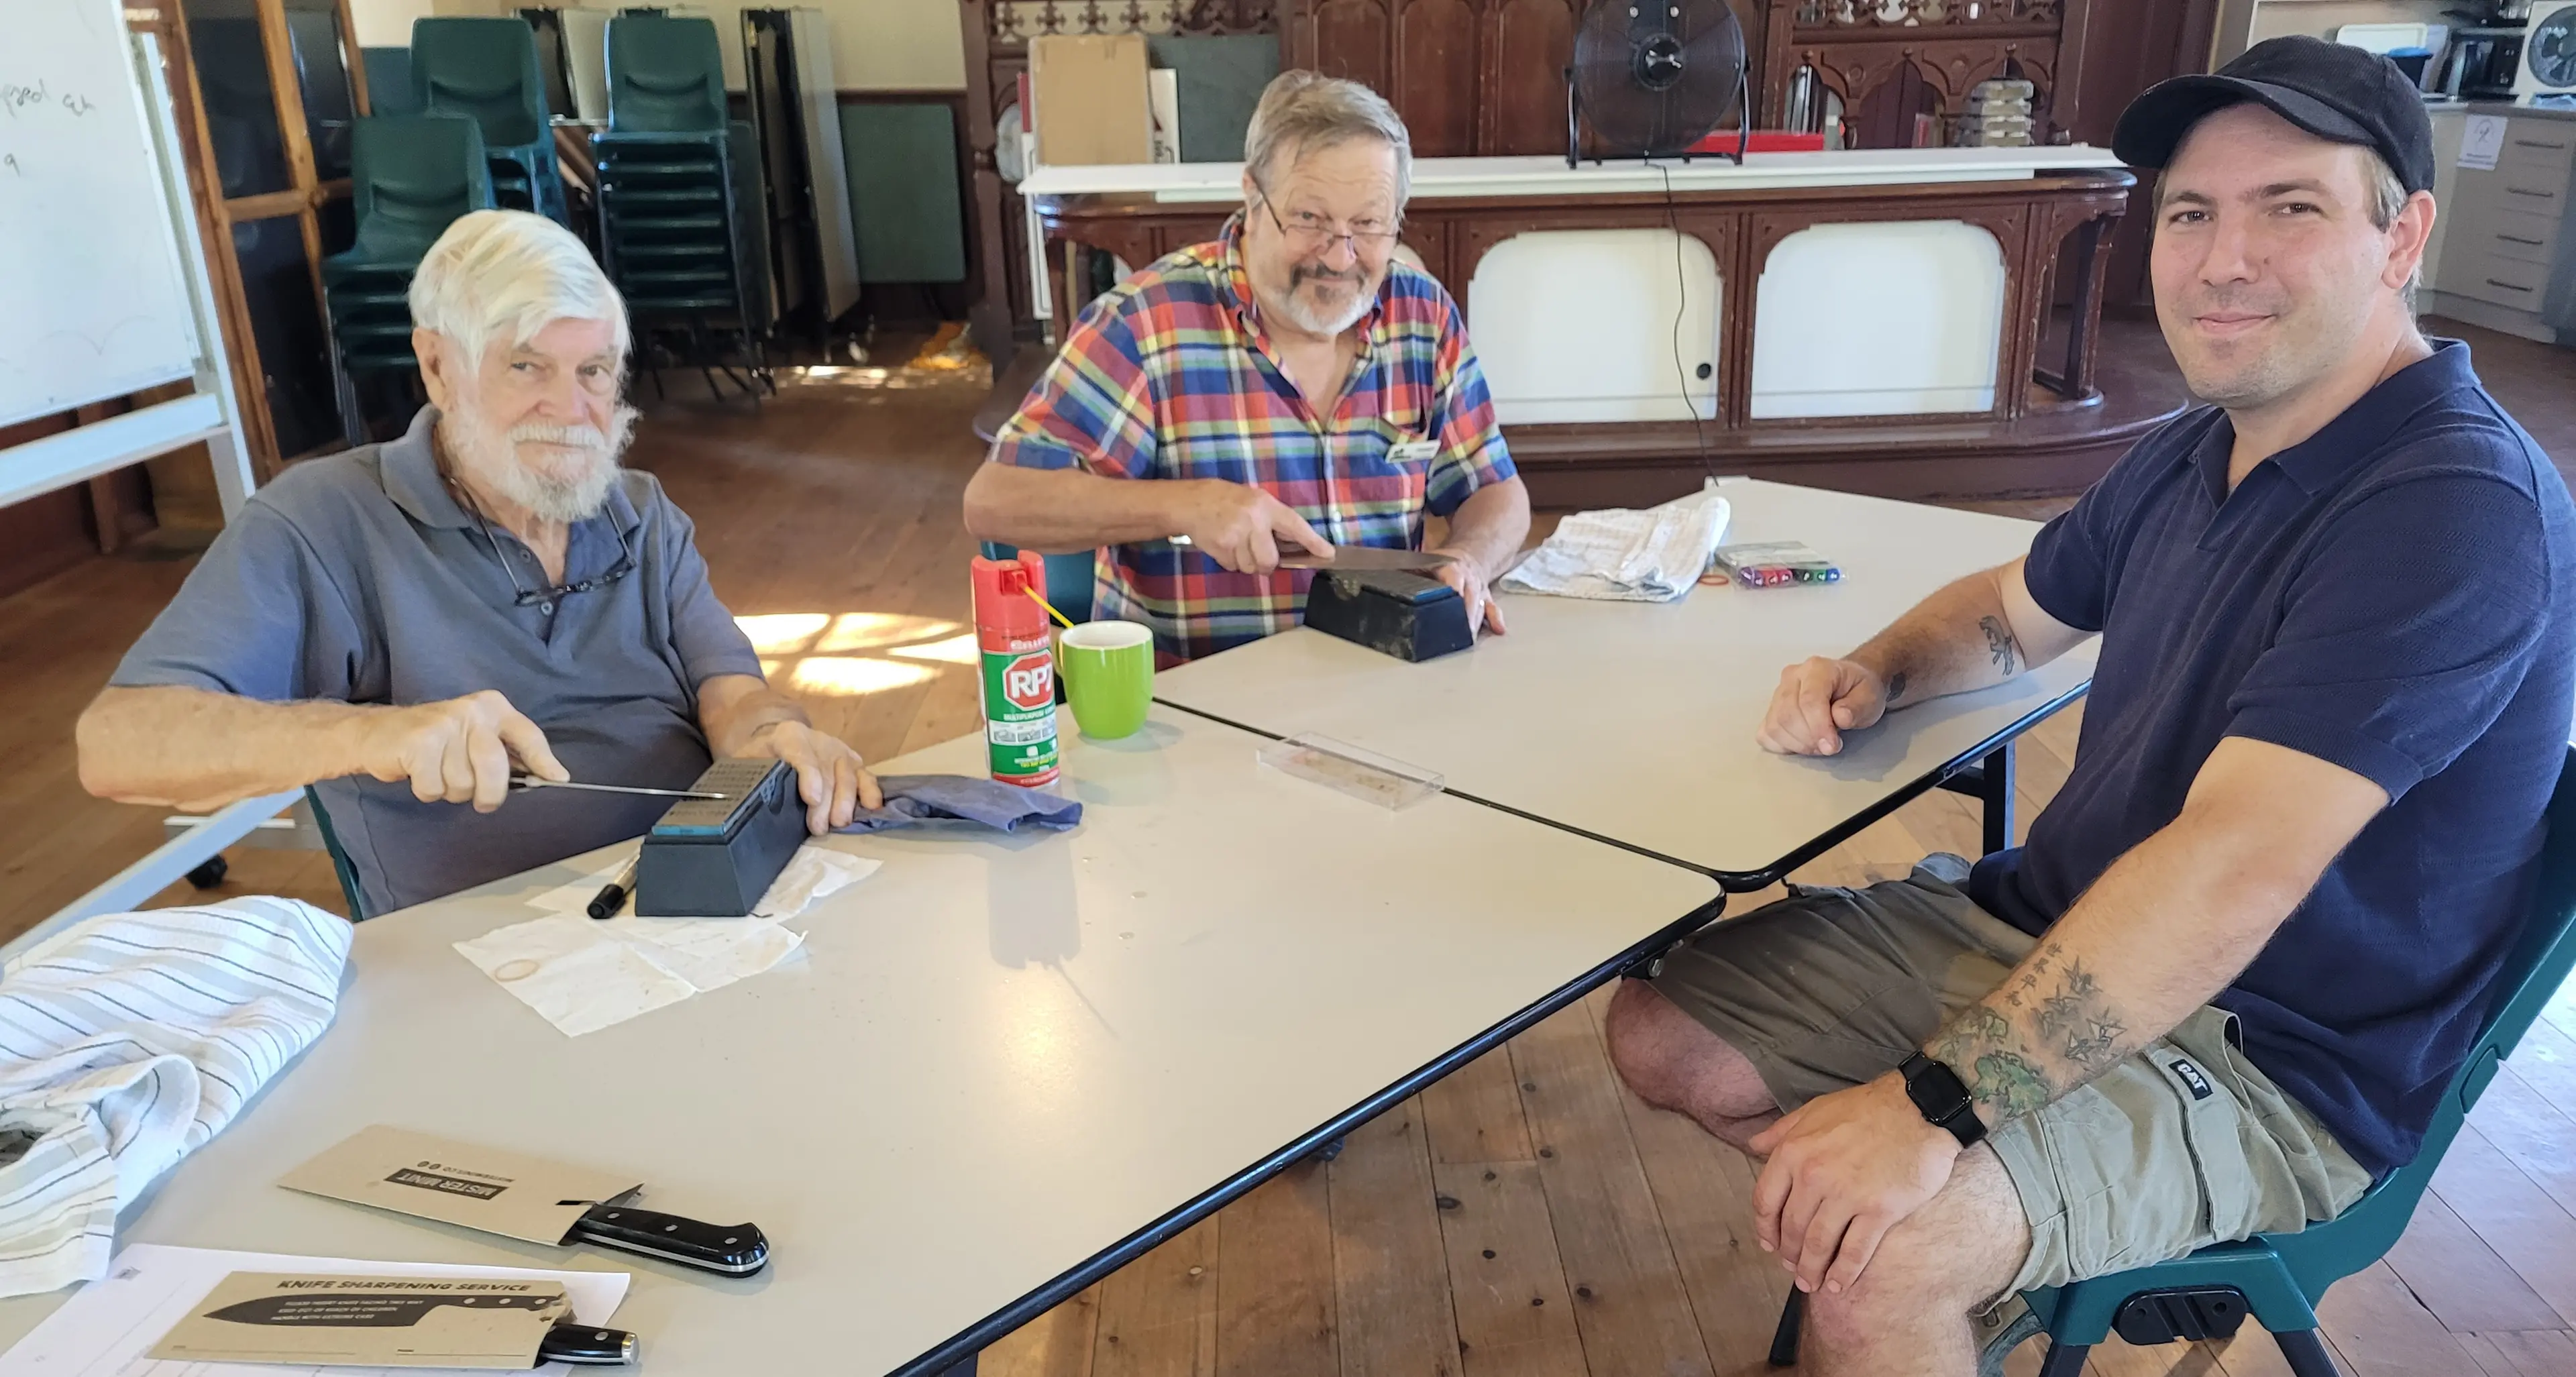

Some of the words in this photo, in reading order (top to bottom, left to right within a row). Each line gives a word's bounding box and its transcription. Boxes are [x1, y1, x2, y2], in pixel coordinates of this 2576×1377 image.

[2177, 1063, 2208, 1091] CAT
[396, 1172, 442, 1187] MINIT
[439, 1180, 497, 1196] MISTER
[277, 1280, 337, 1288] KNIFE
[337, 1281, 452, 1290] SHARPENING
[456, 1283, 531, 1291] SERVICE
